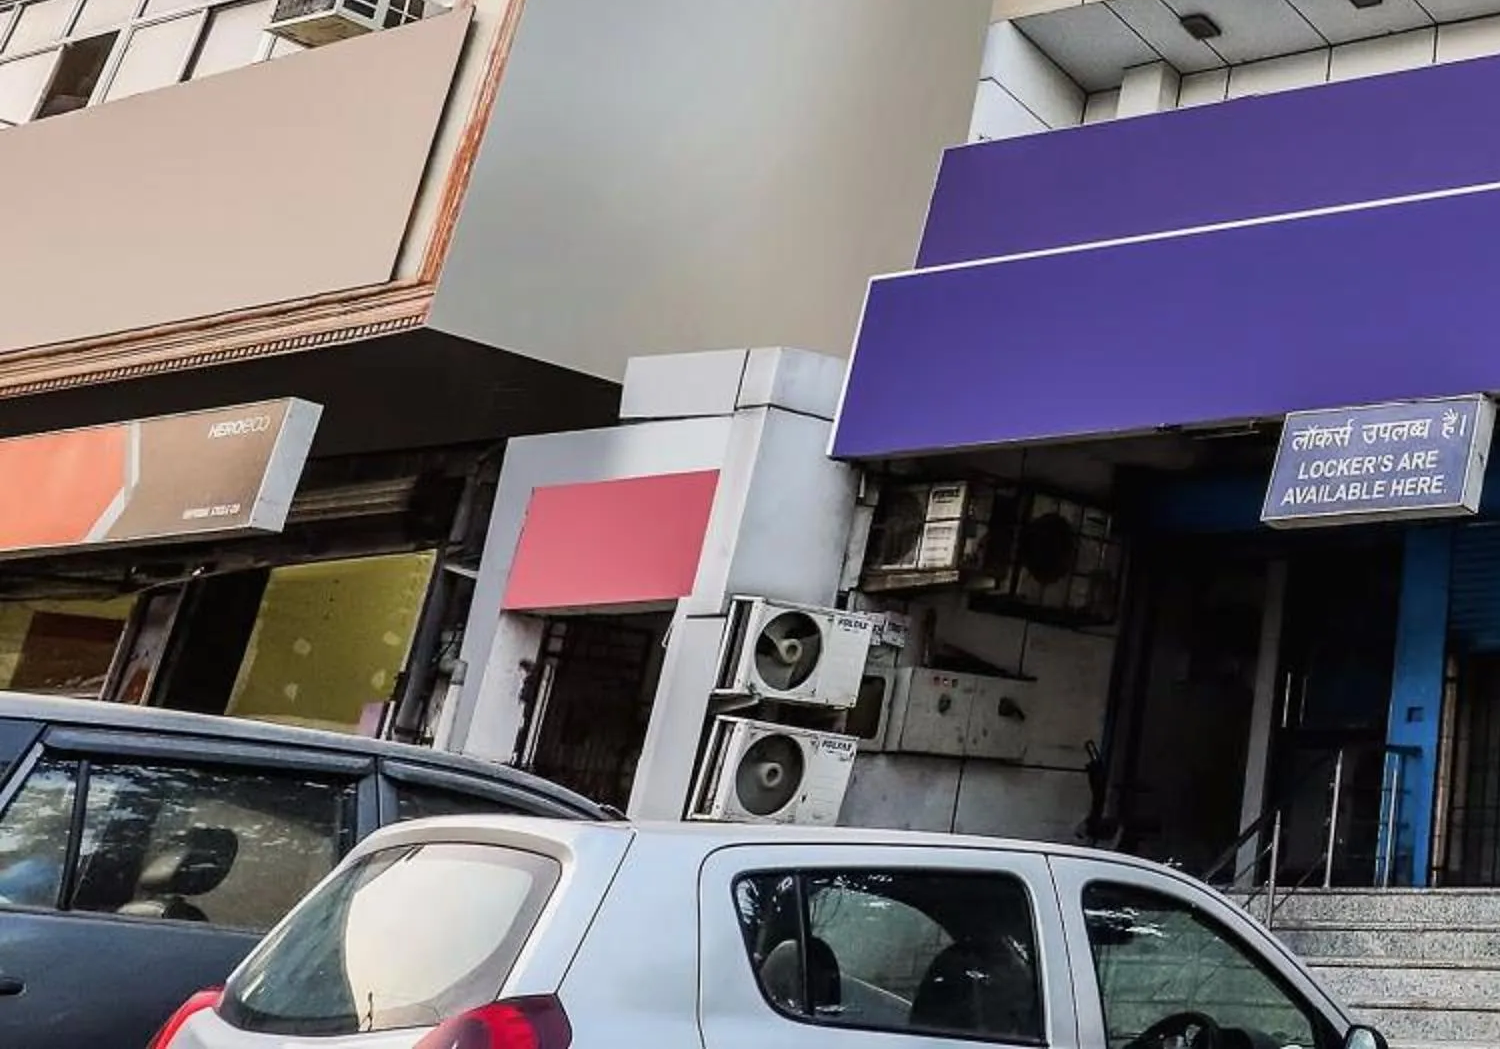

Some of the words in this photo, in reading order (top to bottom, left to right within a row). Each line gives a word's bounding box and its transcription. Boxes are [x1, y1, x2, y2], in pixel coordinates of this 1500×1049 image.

[1298, 455, 1394, 479] LOCKER'S
[1396, 450, 1439, 471] ARE
[1280, 481, 1387, 506] AVAILABLE
[1390, 475, 1447, 497] HERE.
